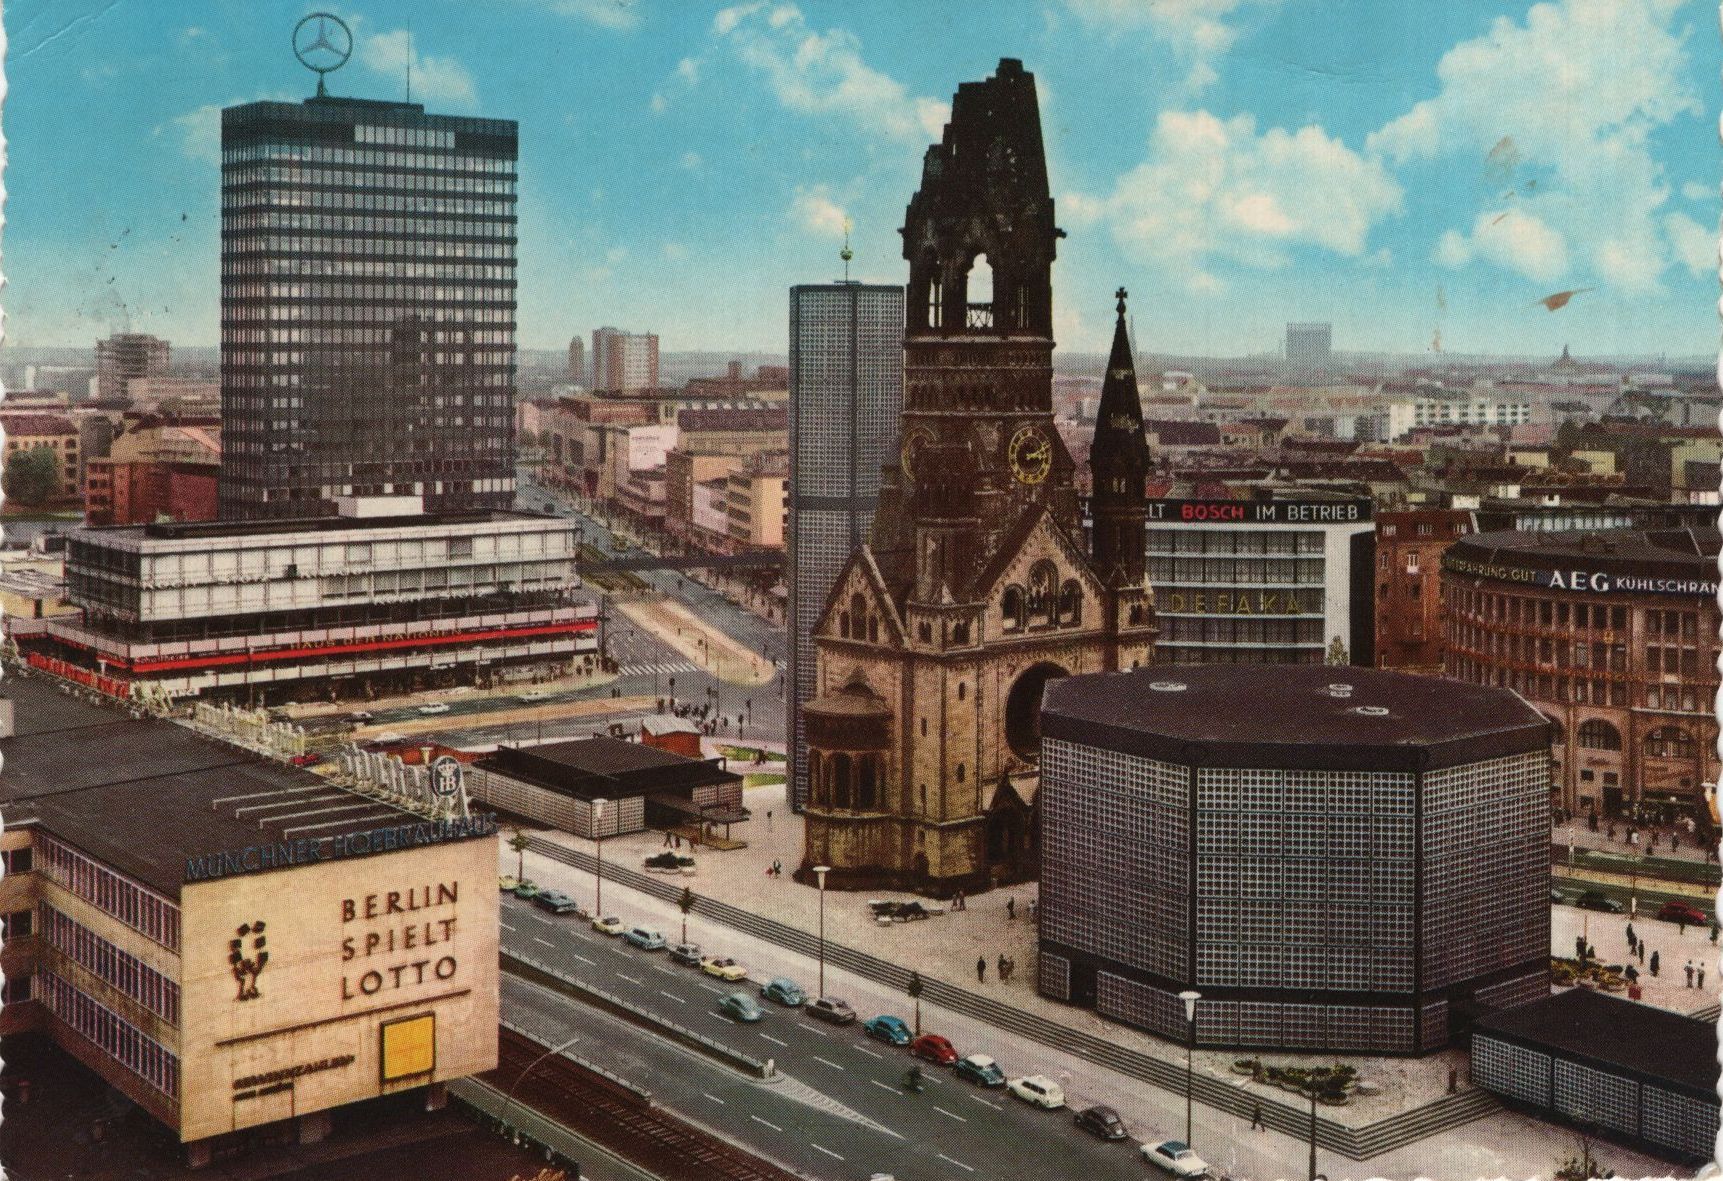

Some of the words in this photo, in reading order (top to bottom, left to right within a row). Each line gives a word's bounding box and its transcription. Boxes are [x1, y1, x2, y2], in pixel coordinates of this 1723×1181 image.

[1181, 503, 1244, 521] BOSCH
[1256, 504, 1275, 521] IM
[1288, 504, 1358, 521] BETRIEB
[1511, 567, 1537, 582] GUT
[1549, 569, 1610, 592] AEG
[1168, 593, 1302, 615] DEFAKA
[382, 627, 463, 642] NATIONEN
[342, 881, 458, 923] BERLIN
[342, 917, 457, 962] SPIELT
[342, 956, 457, 1000] LOTTO
